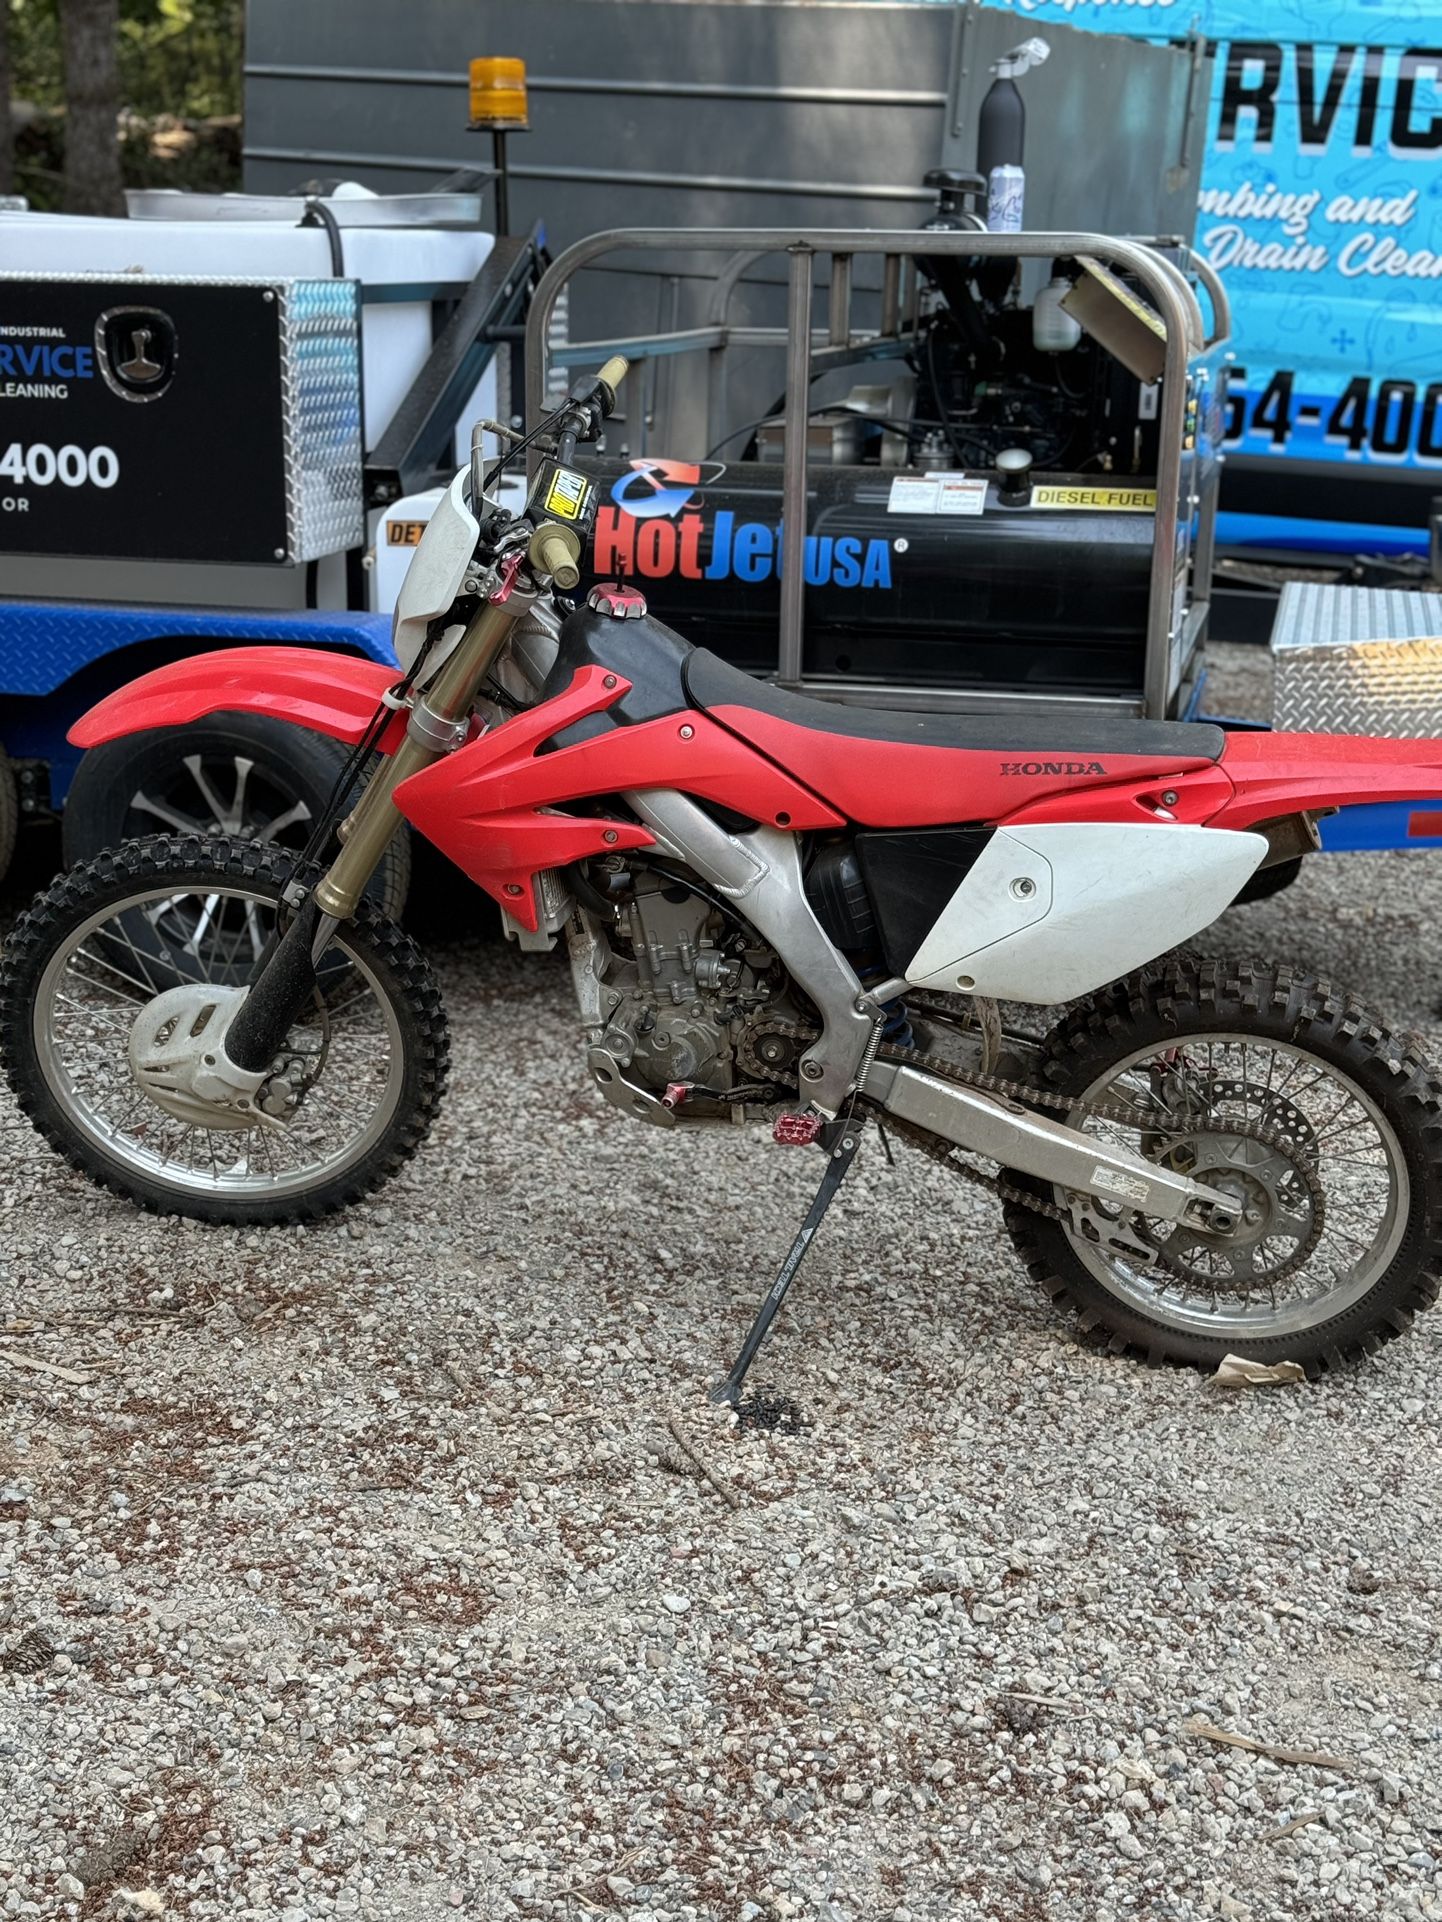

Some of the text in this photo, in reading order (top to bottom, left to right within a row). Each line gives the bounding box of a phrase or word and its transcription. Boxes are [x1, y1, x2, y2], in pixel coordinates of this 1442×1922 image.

[1325, 188, 1419, 225] and
[1203, 224, 1329, 271] Drain
[1037, 490, 1154, 507] DIESEL FUEL
[1000, 762, 1107, 776] HONDA
